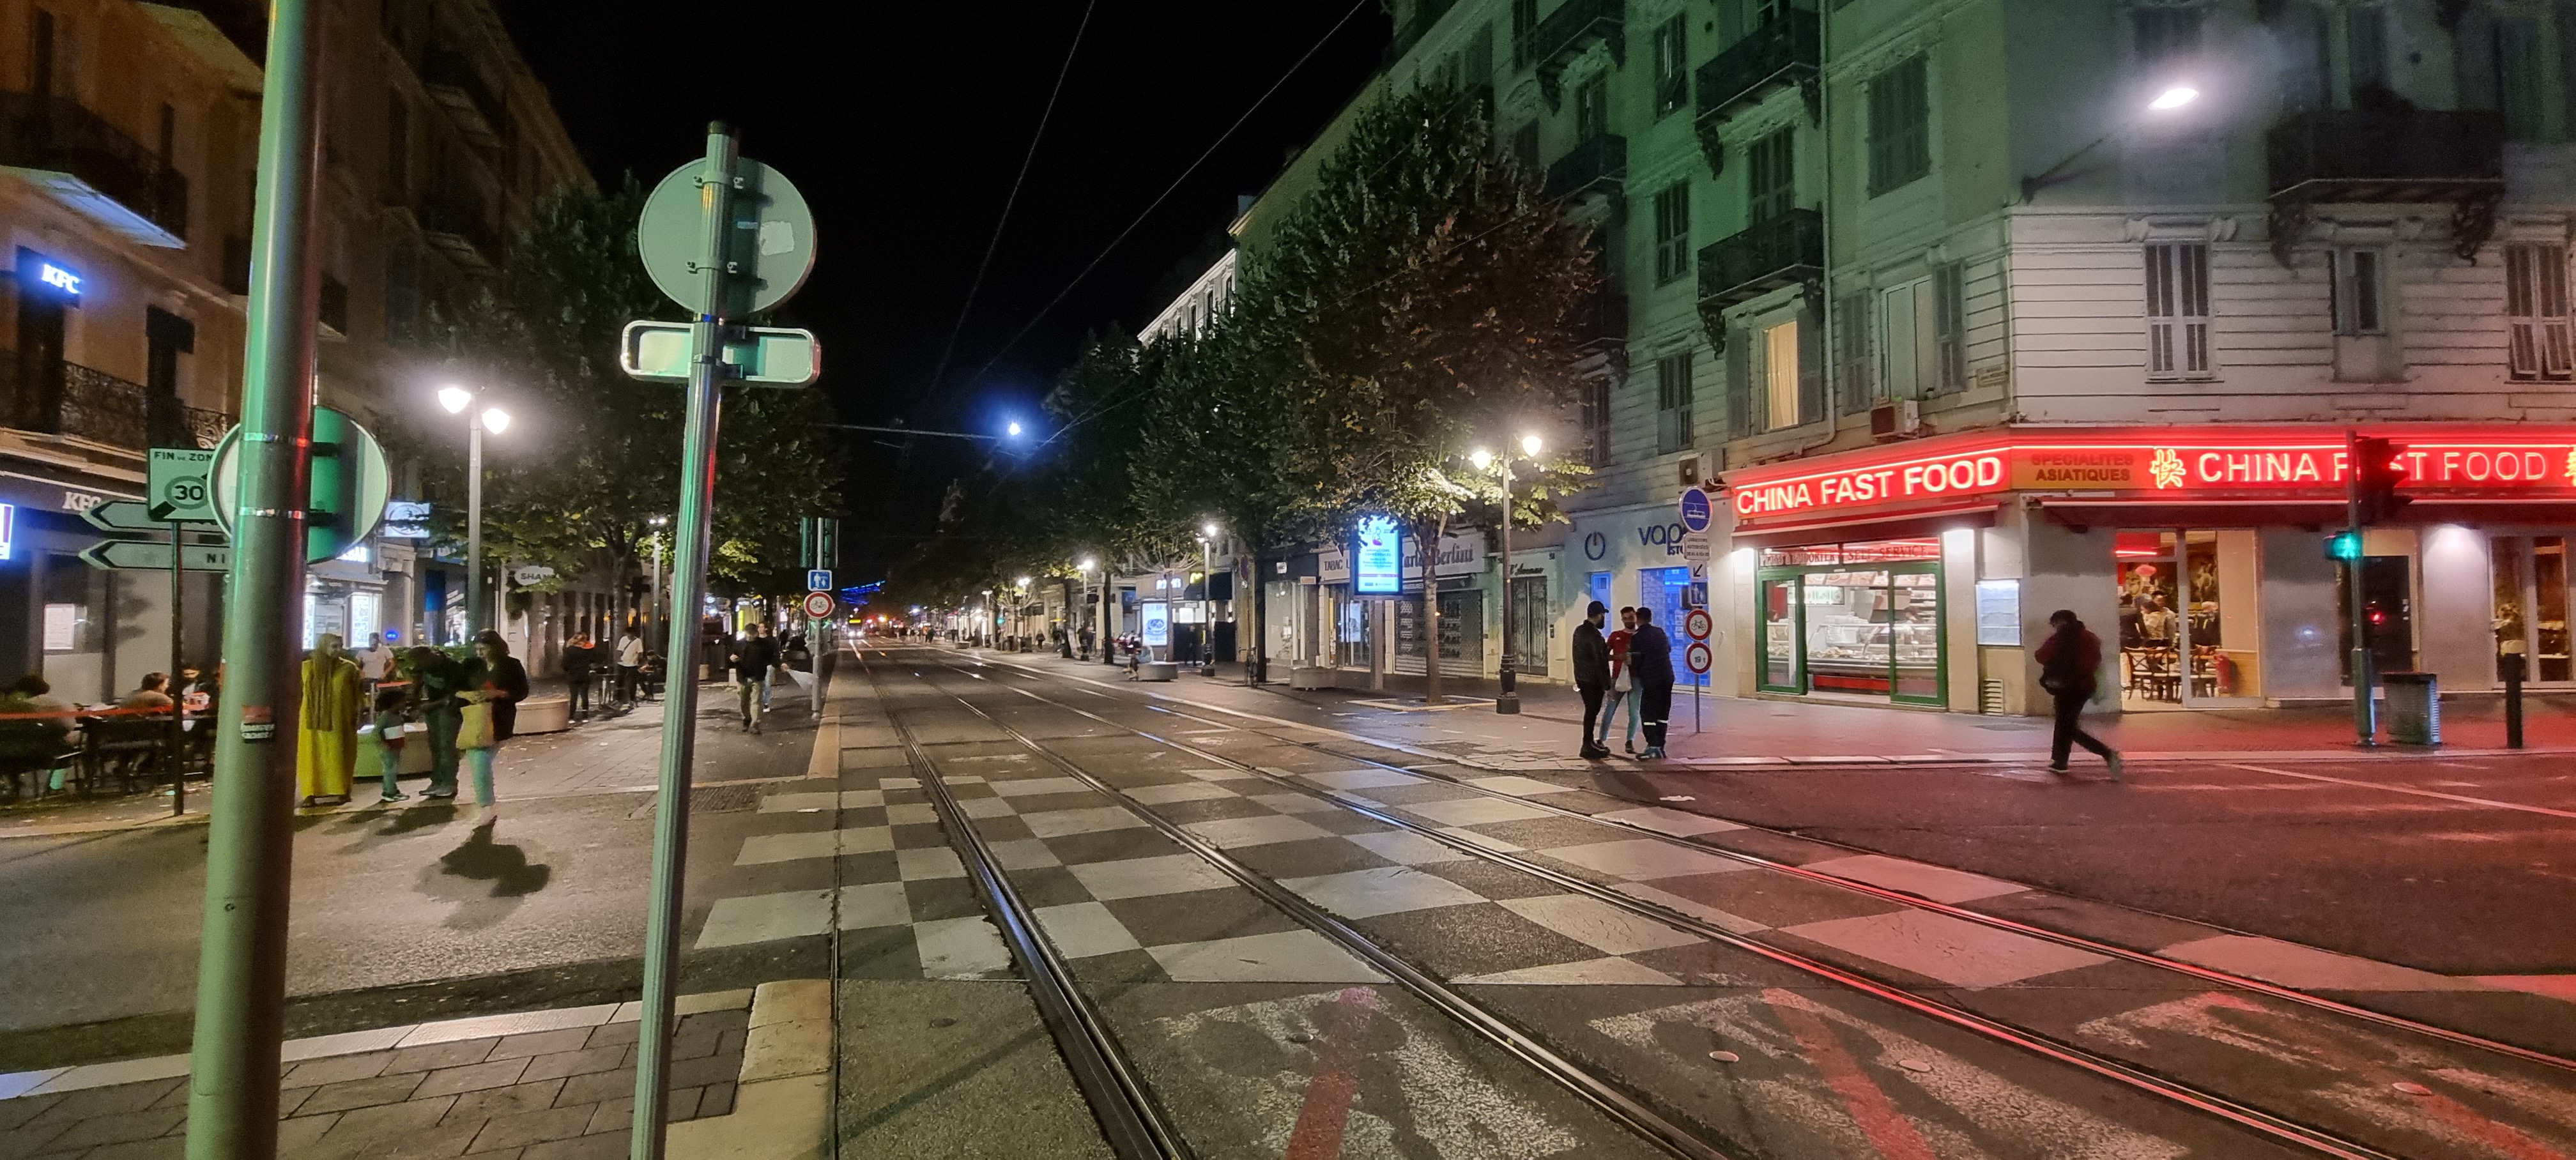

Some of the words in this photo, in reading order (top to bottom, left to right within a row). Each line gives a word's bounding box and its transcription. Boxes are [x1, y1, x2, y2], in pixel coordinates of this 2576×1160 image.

[42, 264, 82, 294] KFC
[154, 451, 174, 460] FIN
[188, 453, 213, 461] ZON
[2032, 454, 2134, 466] SPECIALITES
[2149, 448, 2186, 490] 快
[2198, 452, 2321, 482] CHINA
[2333, 452, 2427, 480] FT
[2443, 451, 2546, 480] FOOD
[2035, 469, 2131, 482] ASIATIQUES
[174, 485, 204, 501] 30
[1736, 483, 1813, 515] CHINA
[1821, 470, 1894, 506] FAST
[1904, 457, 2001, 495] FOOD
[1637, 523, 1688, 555] vap
[1848, 549, 1874, 561] SELF
[1879, 546, 1928, 559] SERVICE
[1324, 559, 1343, 571] TABAC
